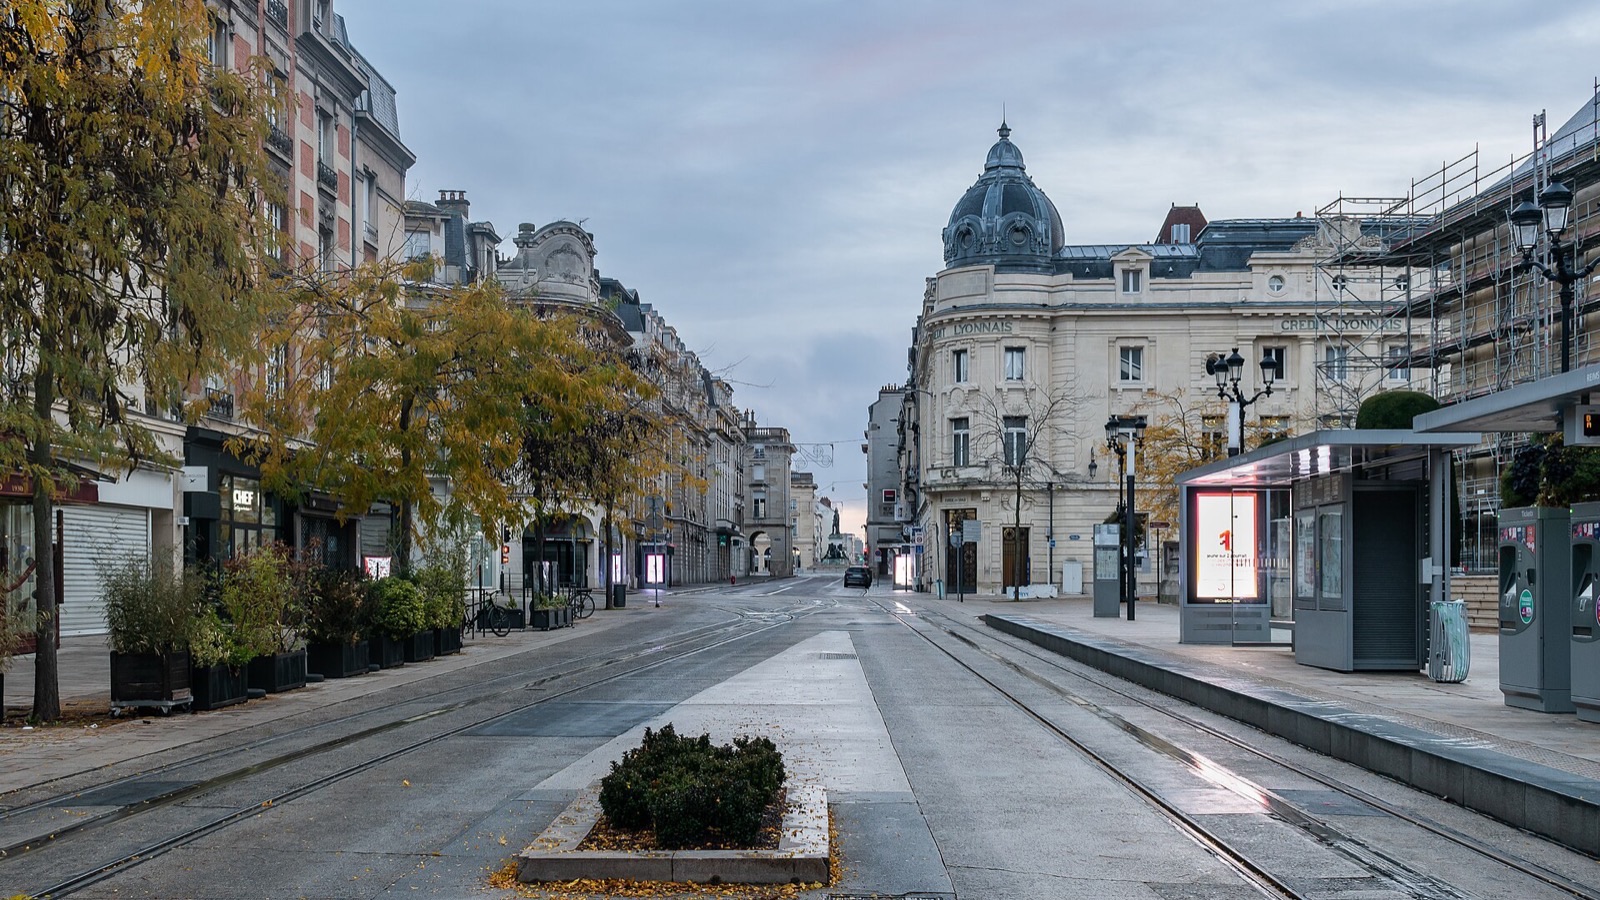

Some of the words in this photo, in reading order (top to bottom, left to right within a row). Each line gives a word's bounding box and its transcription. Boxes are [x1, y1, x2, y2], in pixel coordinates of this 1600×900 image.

[954, 321, 1012, 334] LYONNAIS
[1336, 319, 1402, 330] LYONNAIS
[233, 489, 254, 505] CHEF
